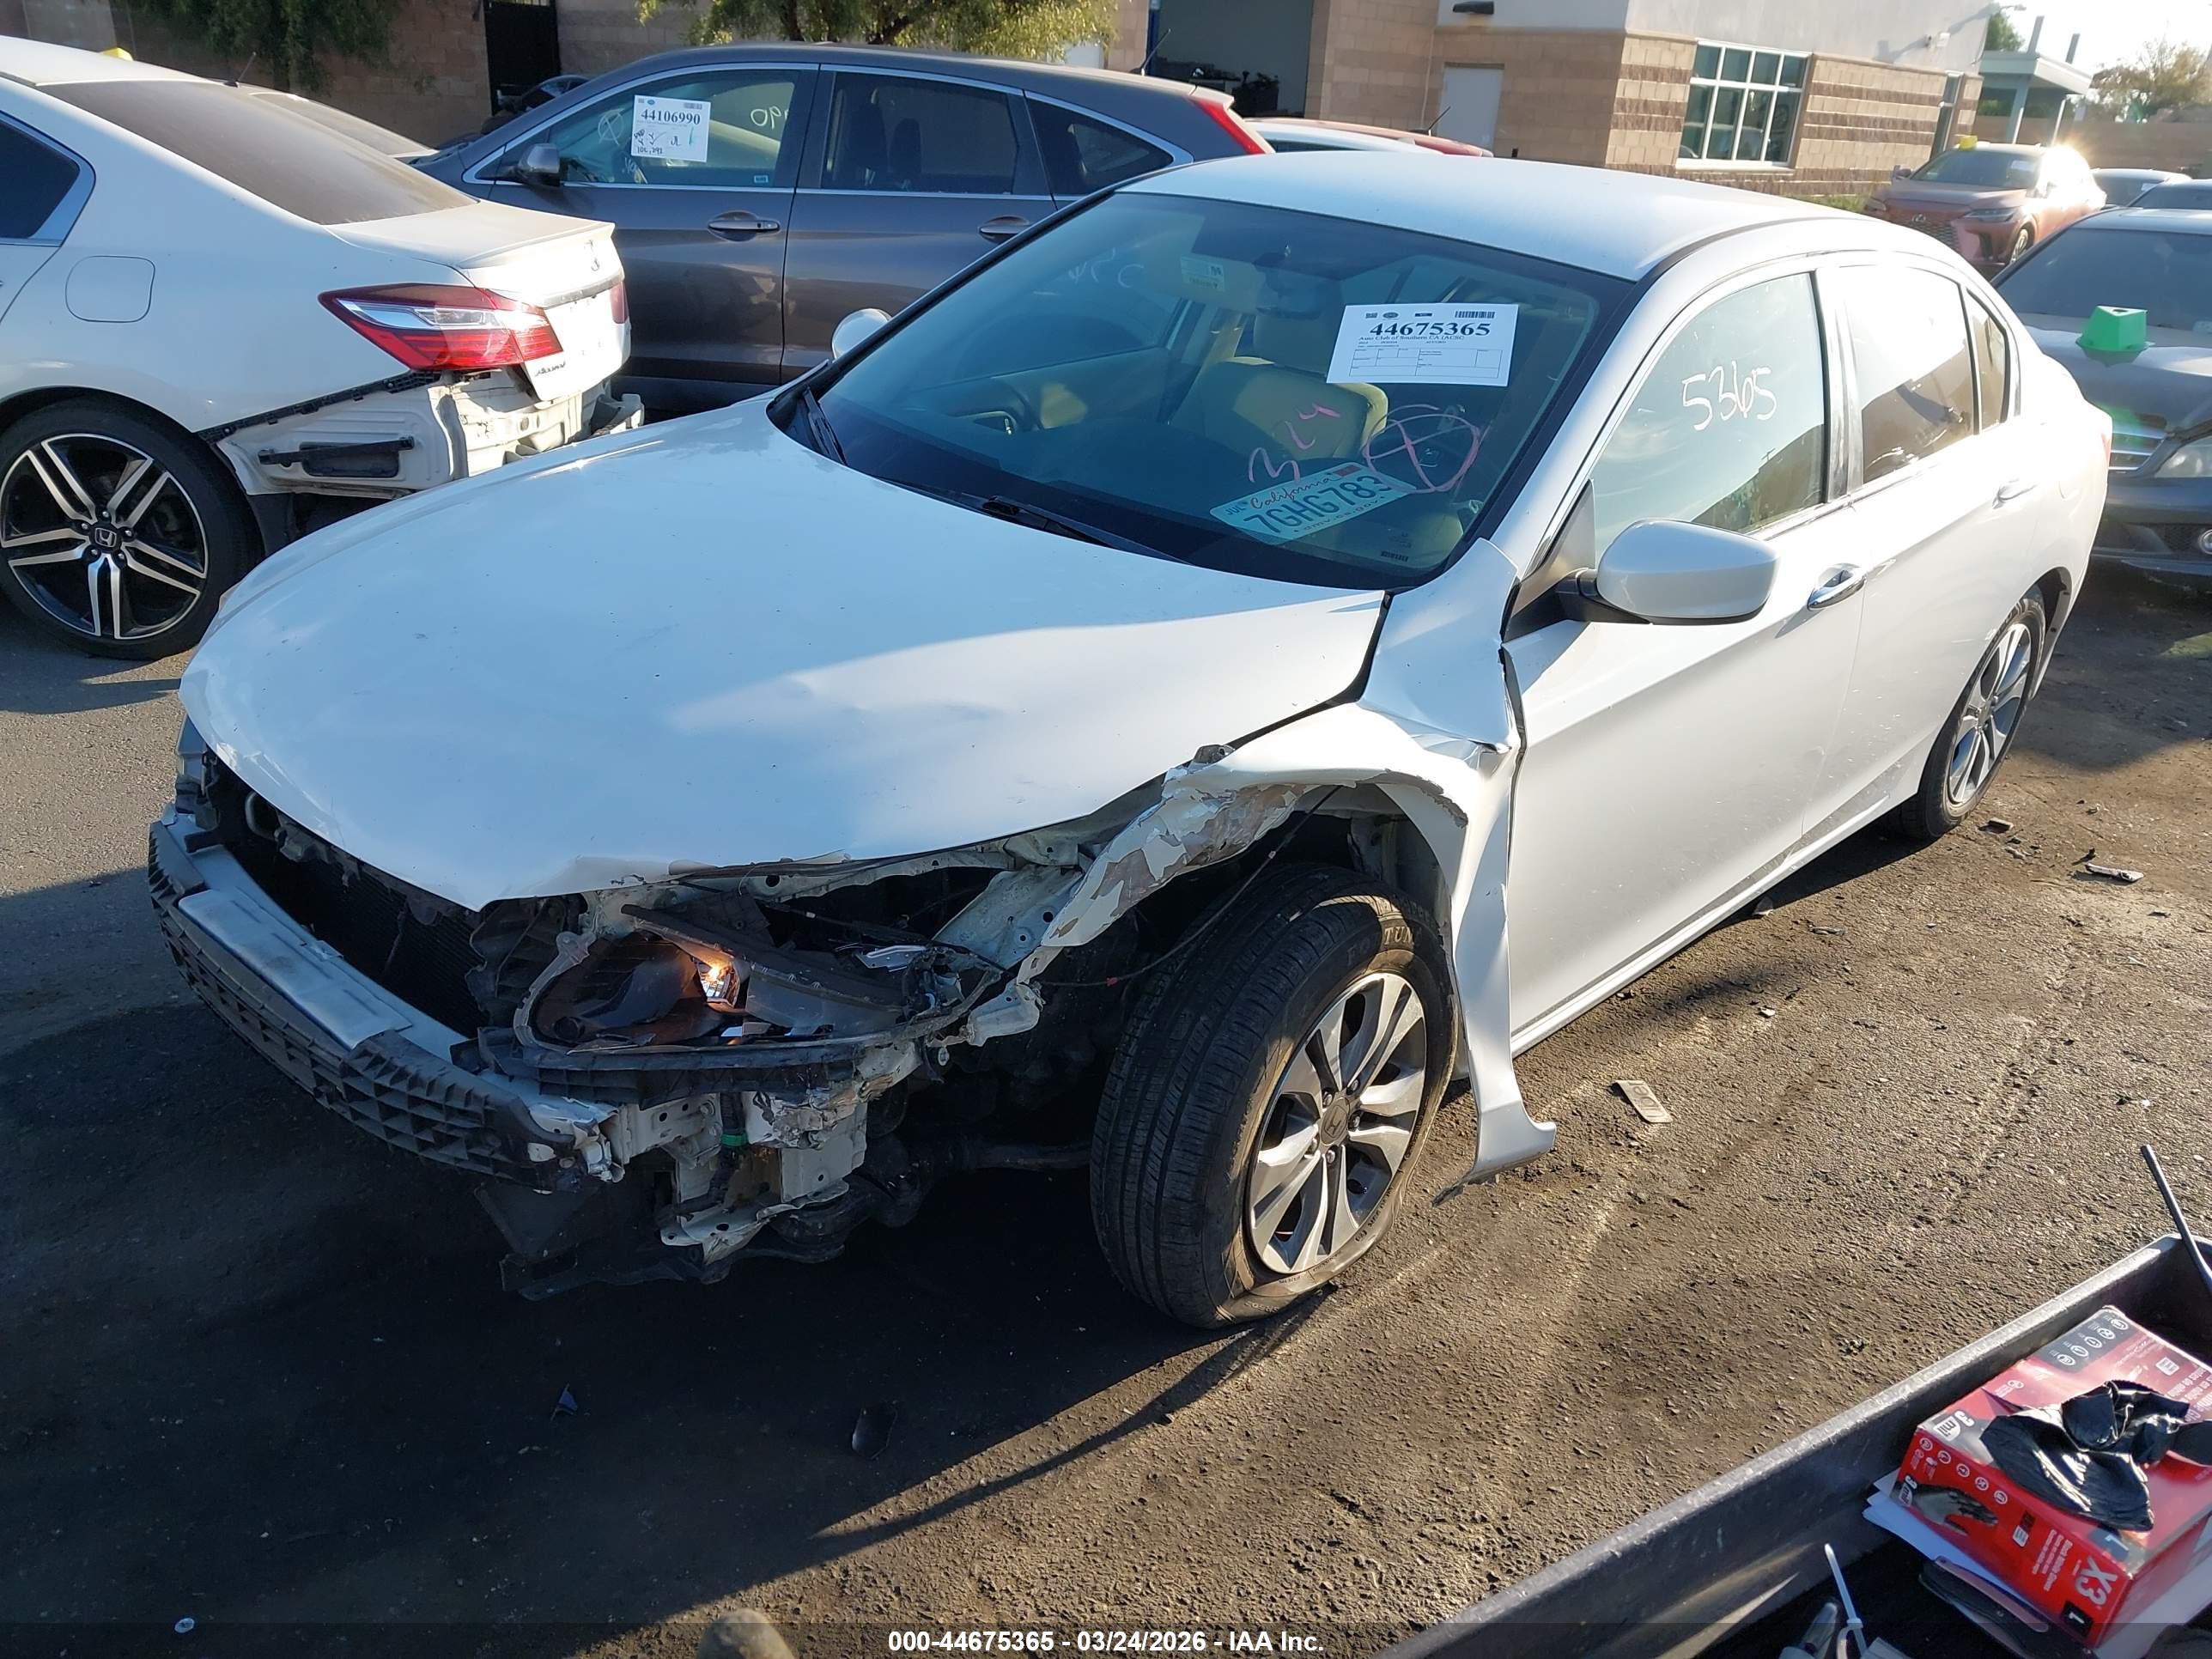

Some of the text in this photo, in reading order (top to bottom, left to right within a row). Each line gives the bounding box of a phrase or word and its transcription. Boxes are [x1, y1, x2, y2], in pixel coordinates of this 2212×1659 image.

[641, 108, 701, 125] 44106990
[1370, 322, 1492, 336] 44675365
[1682, 360, 1777, 430] 5365
[1243, 476, 1392, 533] 7GHG783
[1250, 476, 1340, 508] California
[1937, 1410, 1975, 1437] 3 mil
[1905, 1475, 1917, 1490] 3
[2075, 1555, 2118, 1606] X3
